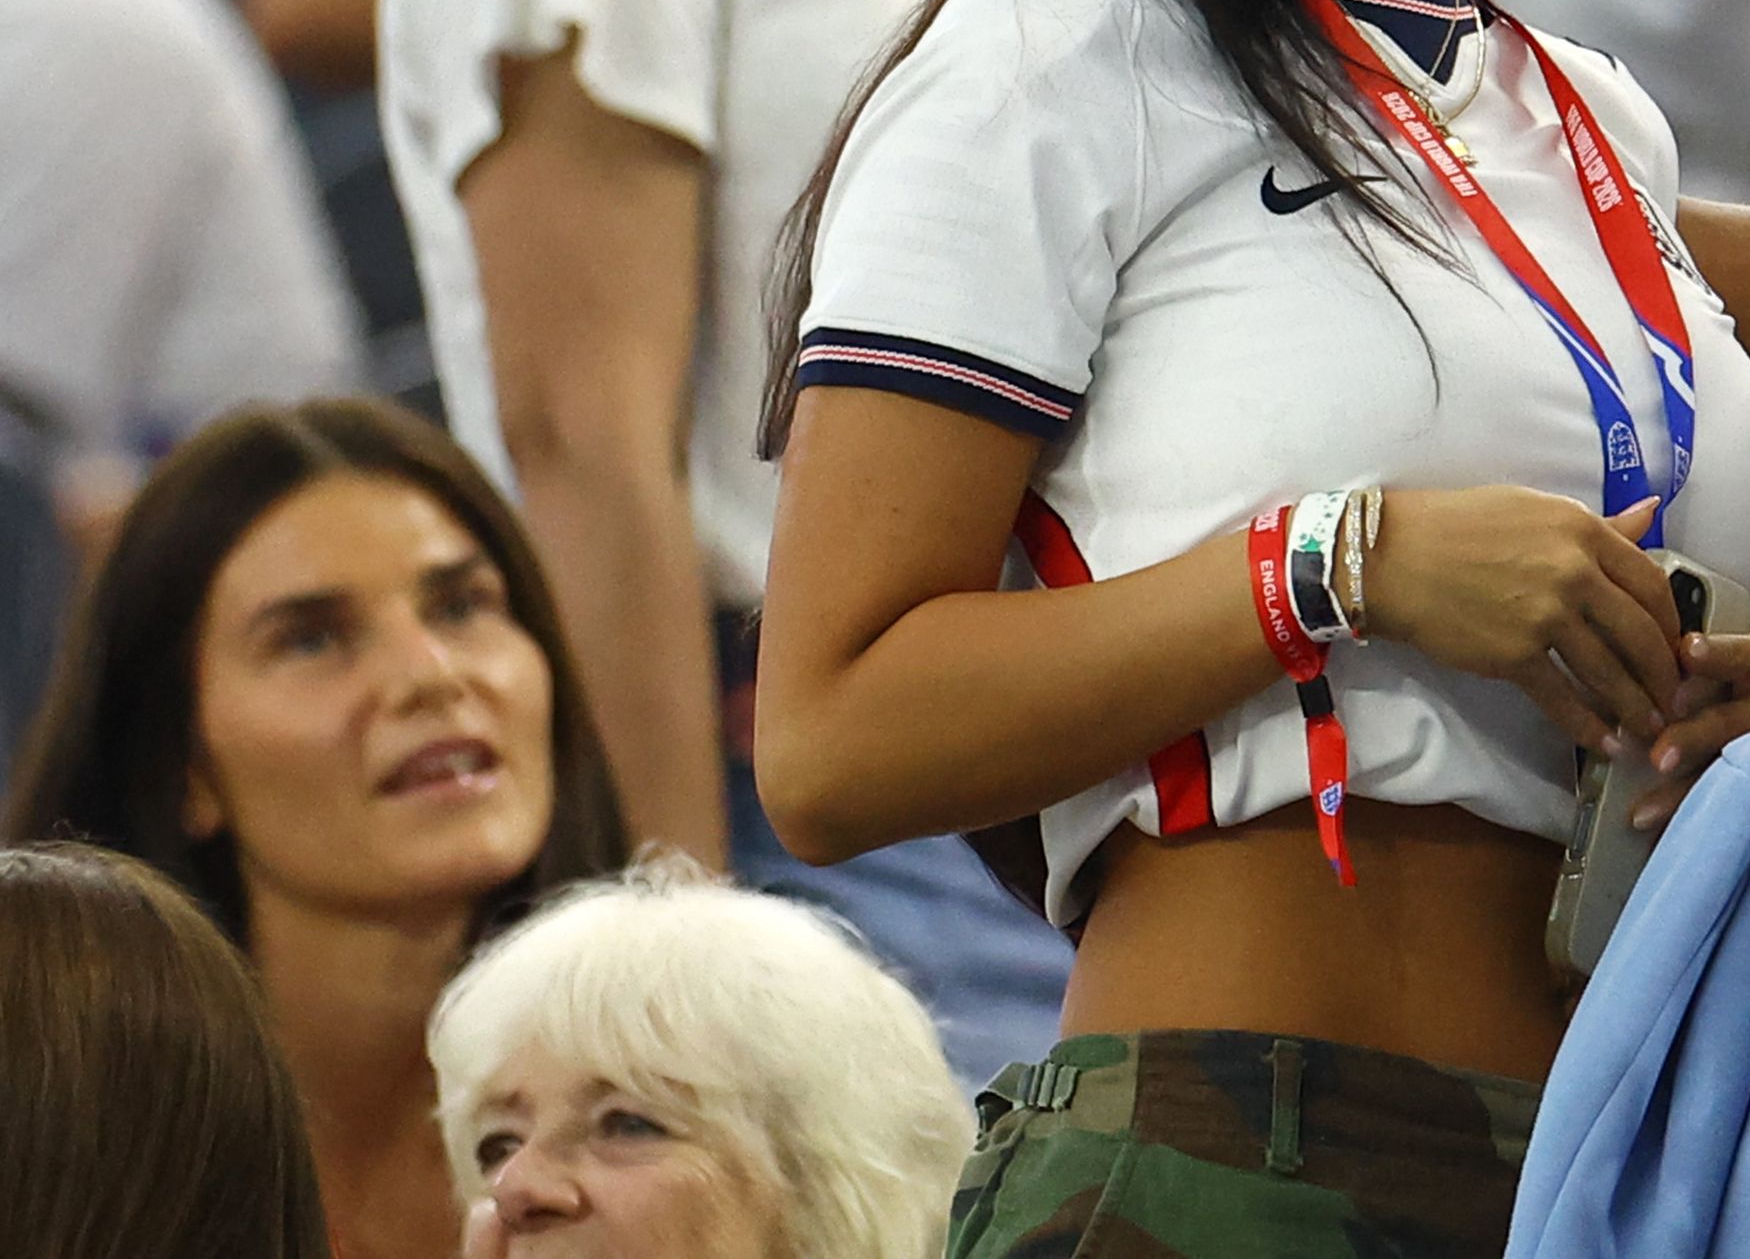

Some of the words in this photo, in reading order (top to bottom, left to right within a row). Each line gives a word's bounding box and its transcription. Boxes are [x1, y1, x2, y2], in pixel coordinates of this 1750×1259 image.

[1381, 91, 1416, 121] 2026
[1403, 121, 1432, 142] CUP
[1572, 122, 1599, 168] WORLD
[1420, 140, 1460, 176] WORLD
[1584, 155, 1609, 185] CUP
[1449, 173, 1478, 197] FIFA
[1592, 175, 1622, 213] 2026
[1259, 559, 1291, 643] ENGLAND
